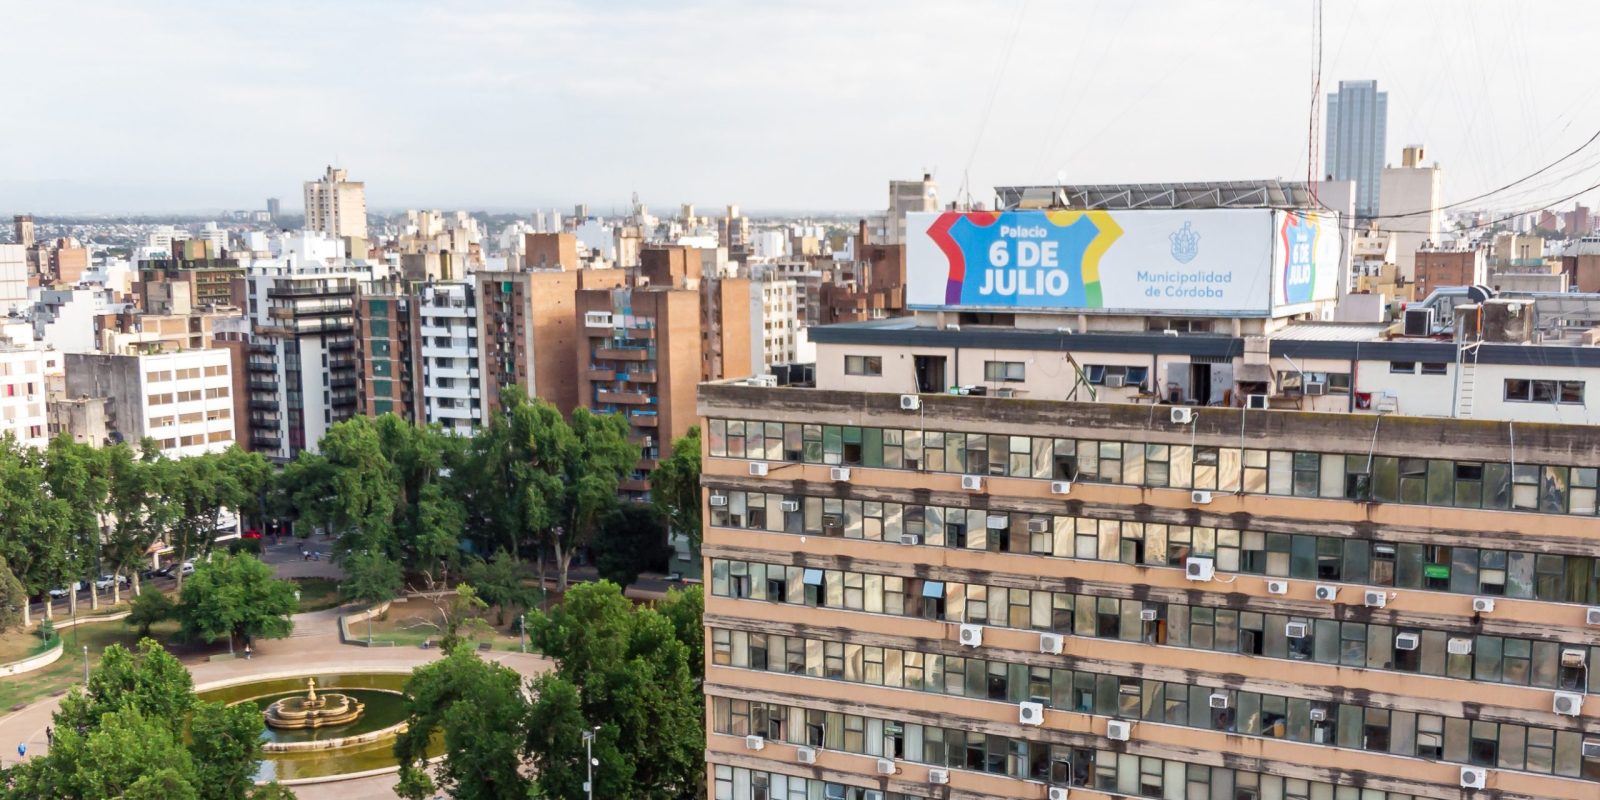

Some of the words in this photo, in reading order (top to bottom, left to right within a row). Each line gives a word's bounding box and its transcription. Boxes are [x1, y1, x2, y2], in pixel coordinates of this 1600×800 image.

[1000, 225, 1047, 237] Palacio
[989, 240, 1009, 267] 6
[1017, 241, 1058, 267] DE
[1292, 243, 1299, 263] 6
[979, 269, 1069, 296] JULIO
[1137, 271, 1232, 284] Municipalidad
[1288, 264, 1311, 285] JULIO
[1145, 286, 1160, 297] de
[1165, 285, 1223, 297] Córdoba
